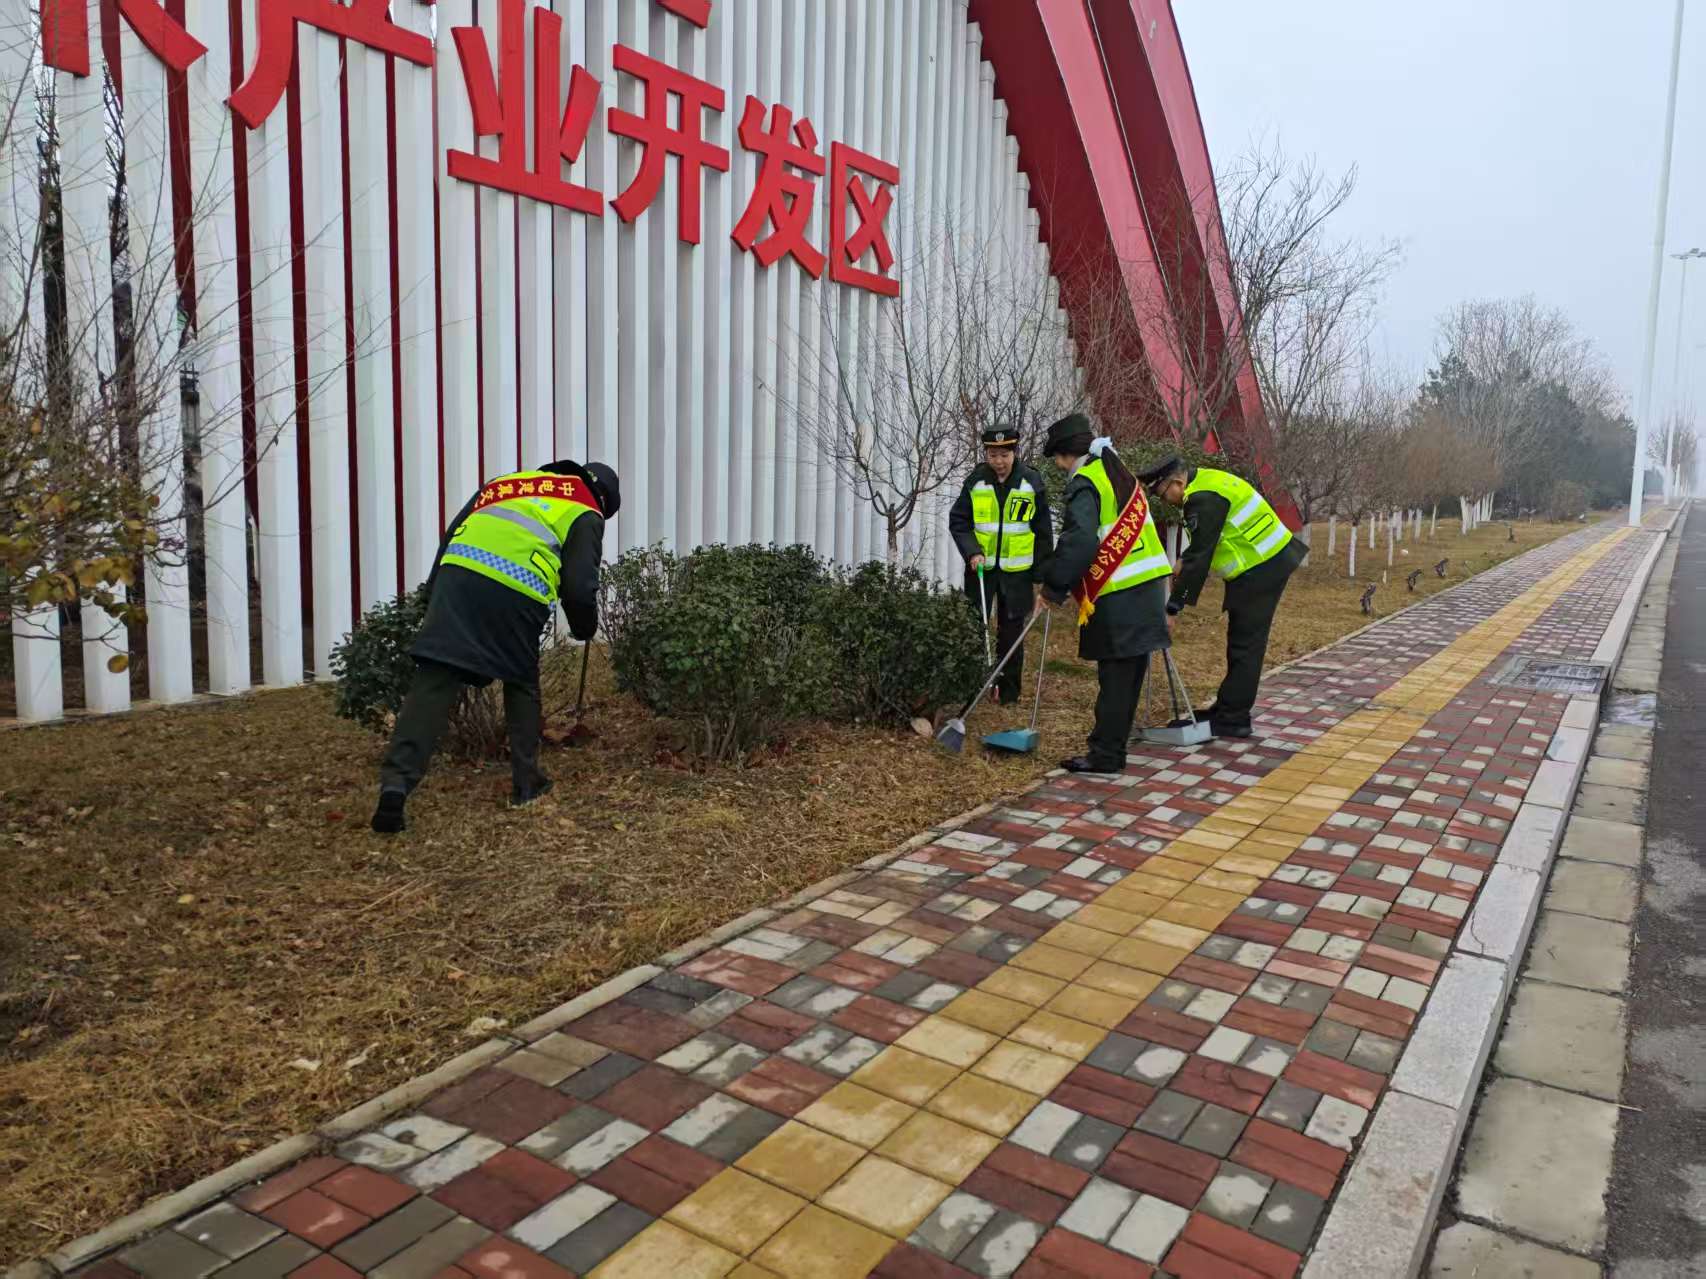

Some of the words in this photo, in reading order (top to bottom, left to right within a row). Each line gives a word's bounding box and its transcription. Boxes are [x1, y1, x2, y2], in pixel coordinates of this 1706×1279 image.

[474, 479, 575, 508] 中电建冀交
